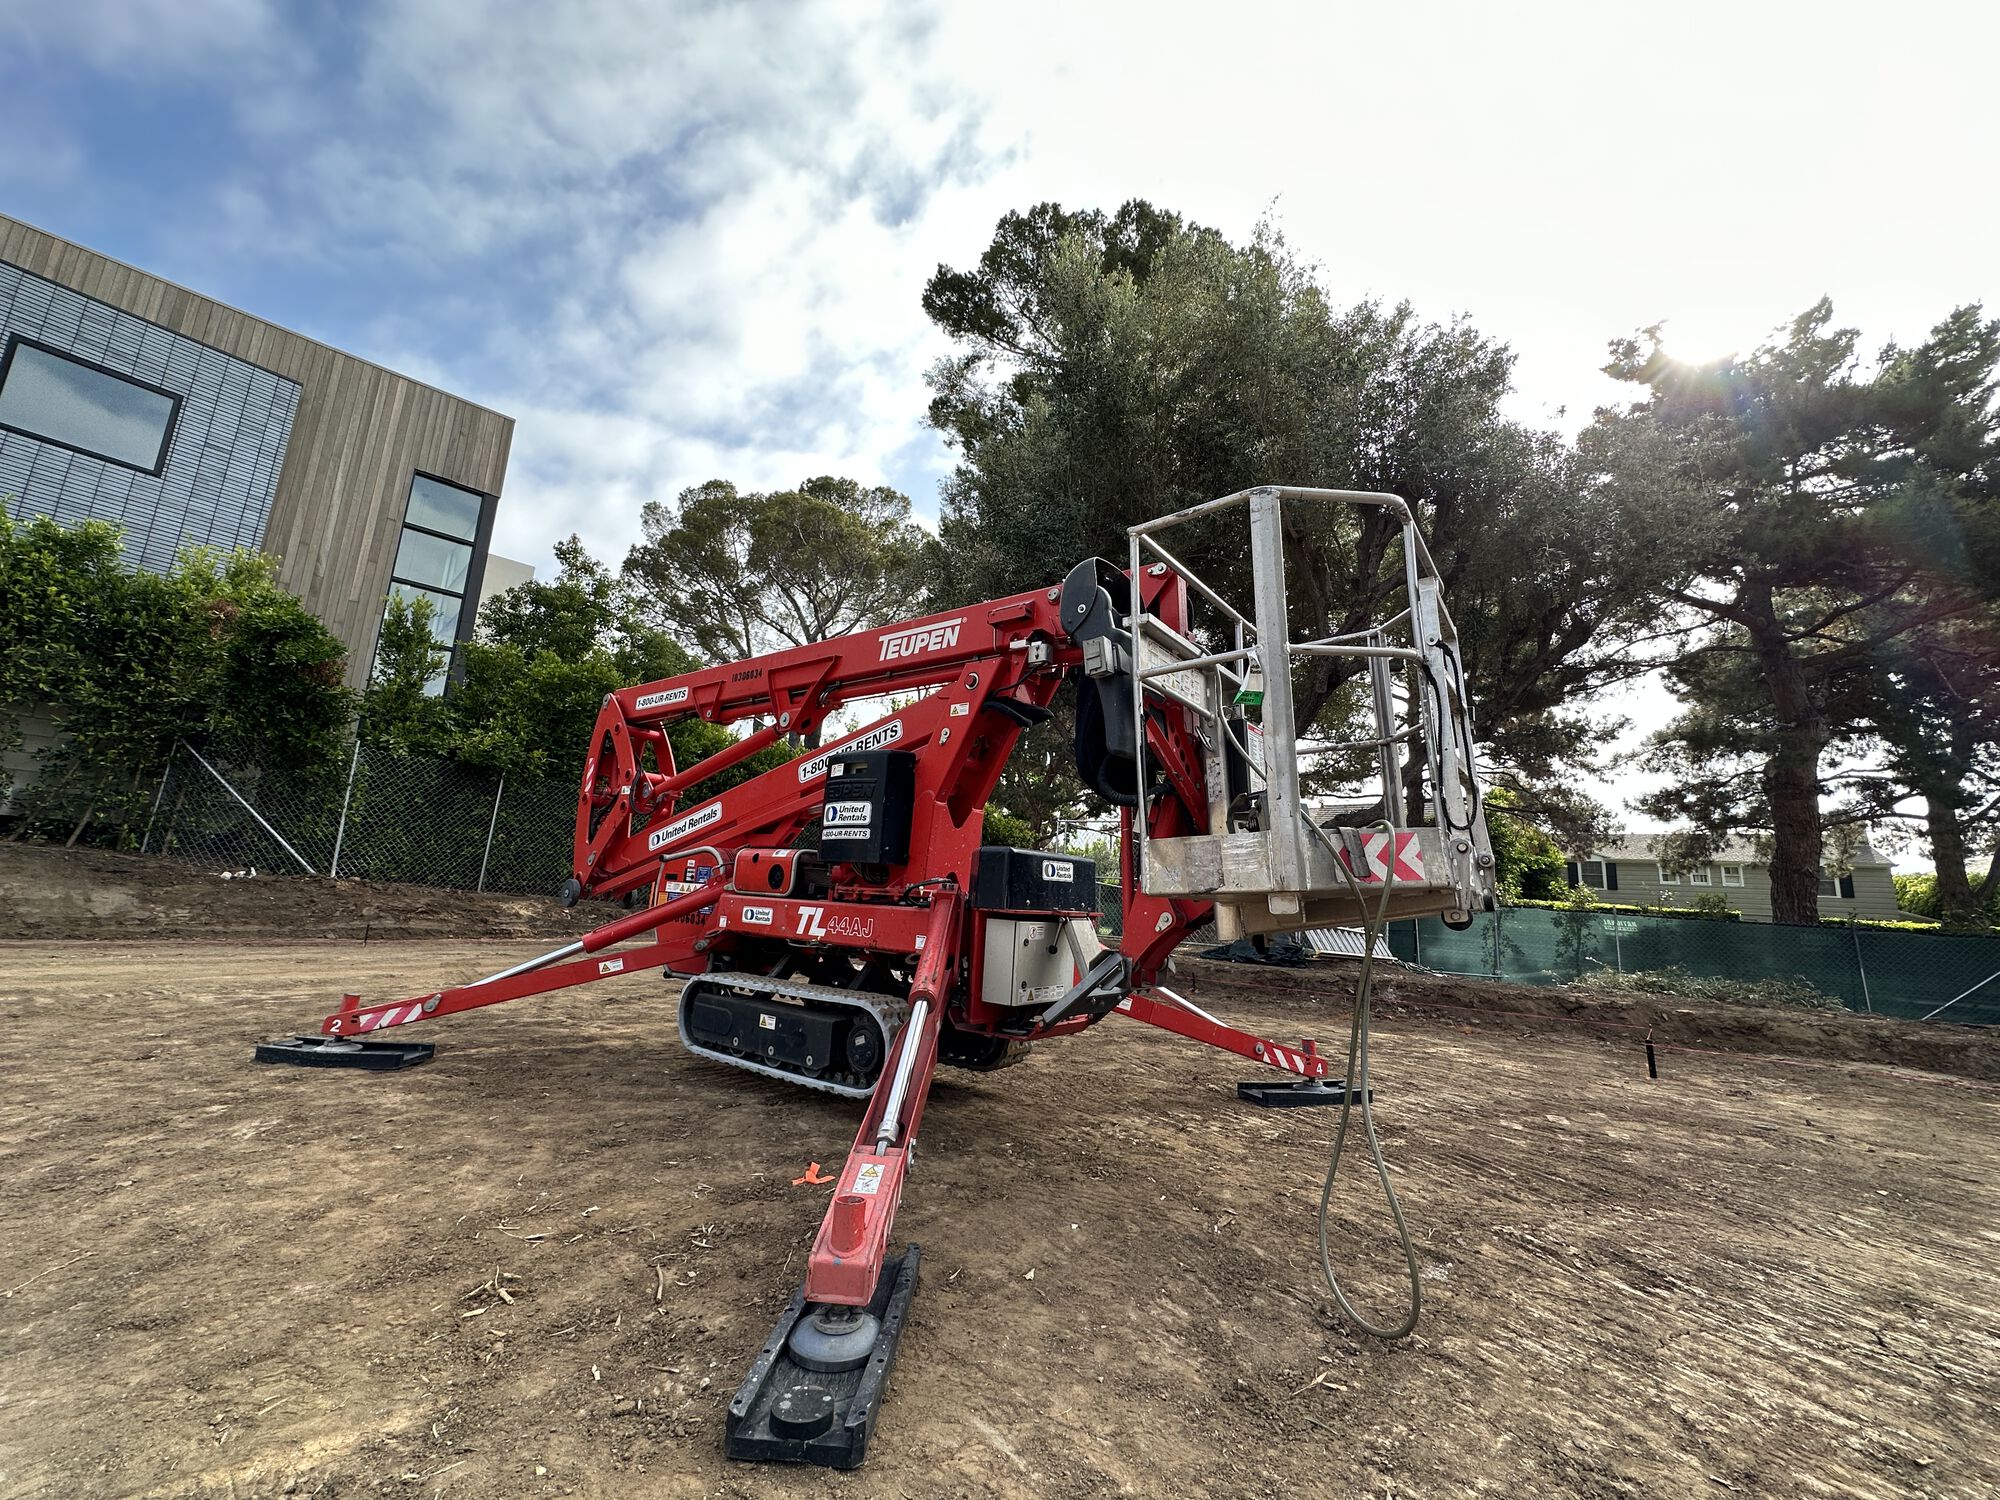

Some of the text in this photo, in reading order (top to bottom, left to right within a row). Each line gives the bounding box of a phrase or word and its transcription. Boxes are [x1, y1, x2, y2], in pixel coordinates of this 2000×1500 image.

[879, 618, 962, 661] TEUPEN
[637, 690, 687, 707] 1-800-UR-RENTS
[839, 805, 866, 813] United
[661, 808, 718, 841] United Rentals
[838, 813, 867, 822] Rentals
[796, 906, 874, 938] TL 44AJ
[329, 1019, 342, 1032] 2
[1316, 1062, 1323, 1074] 4
